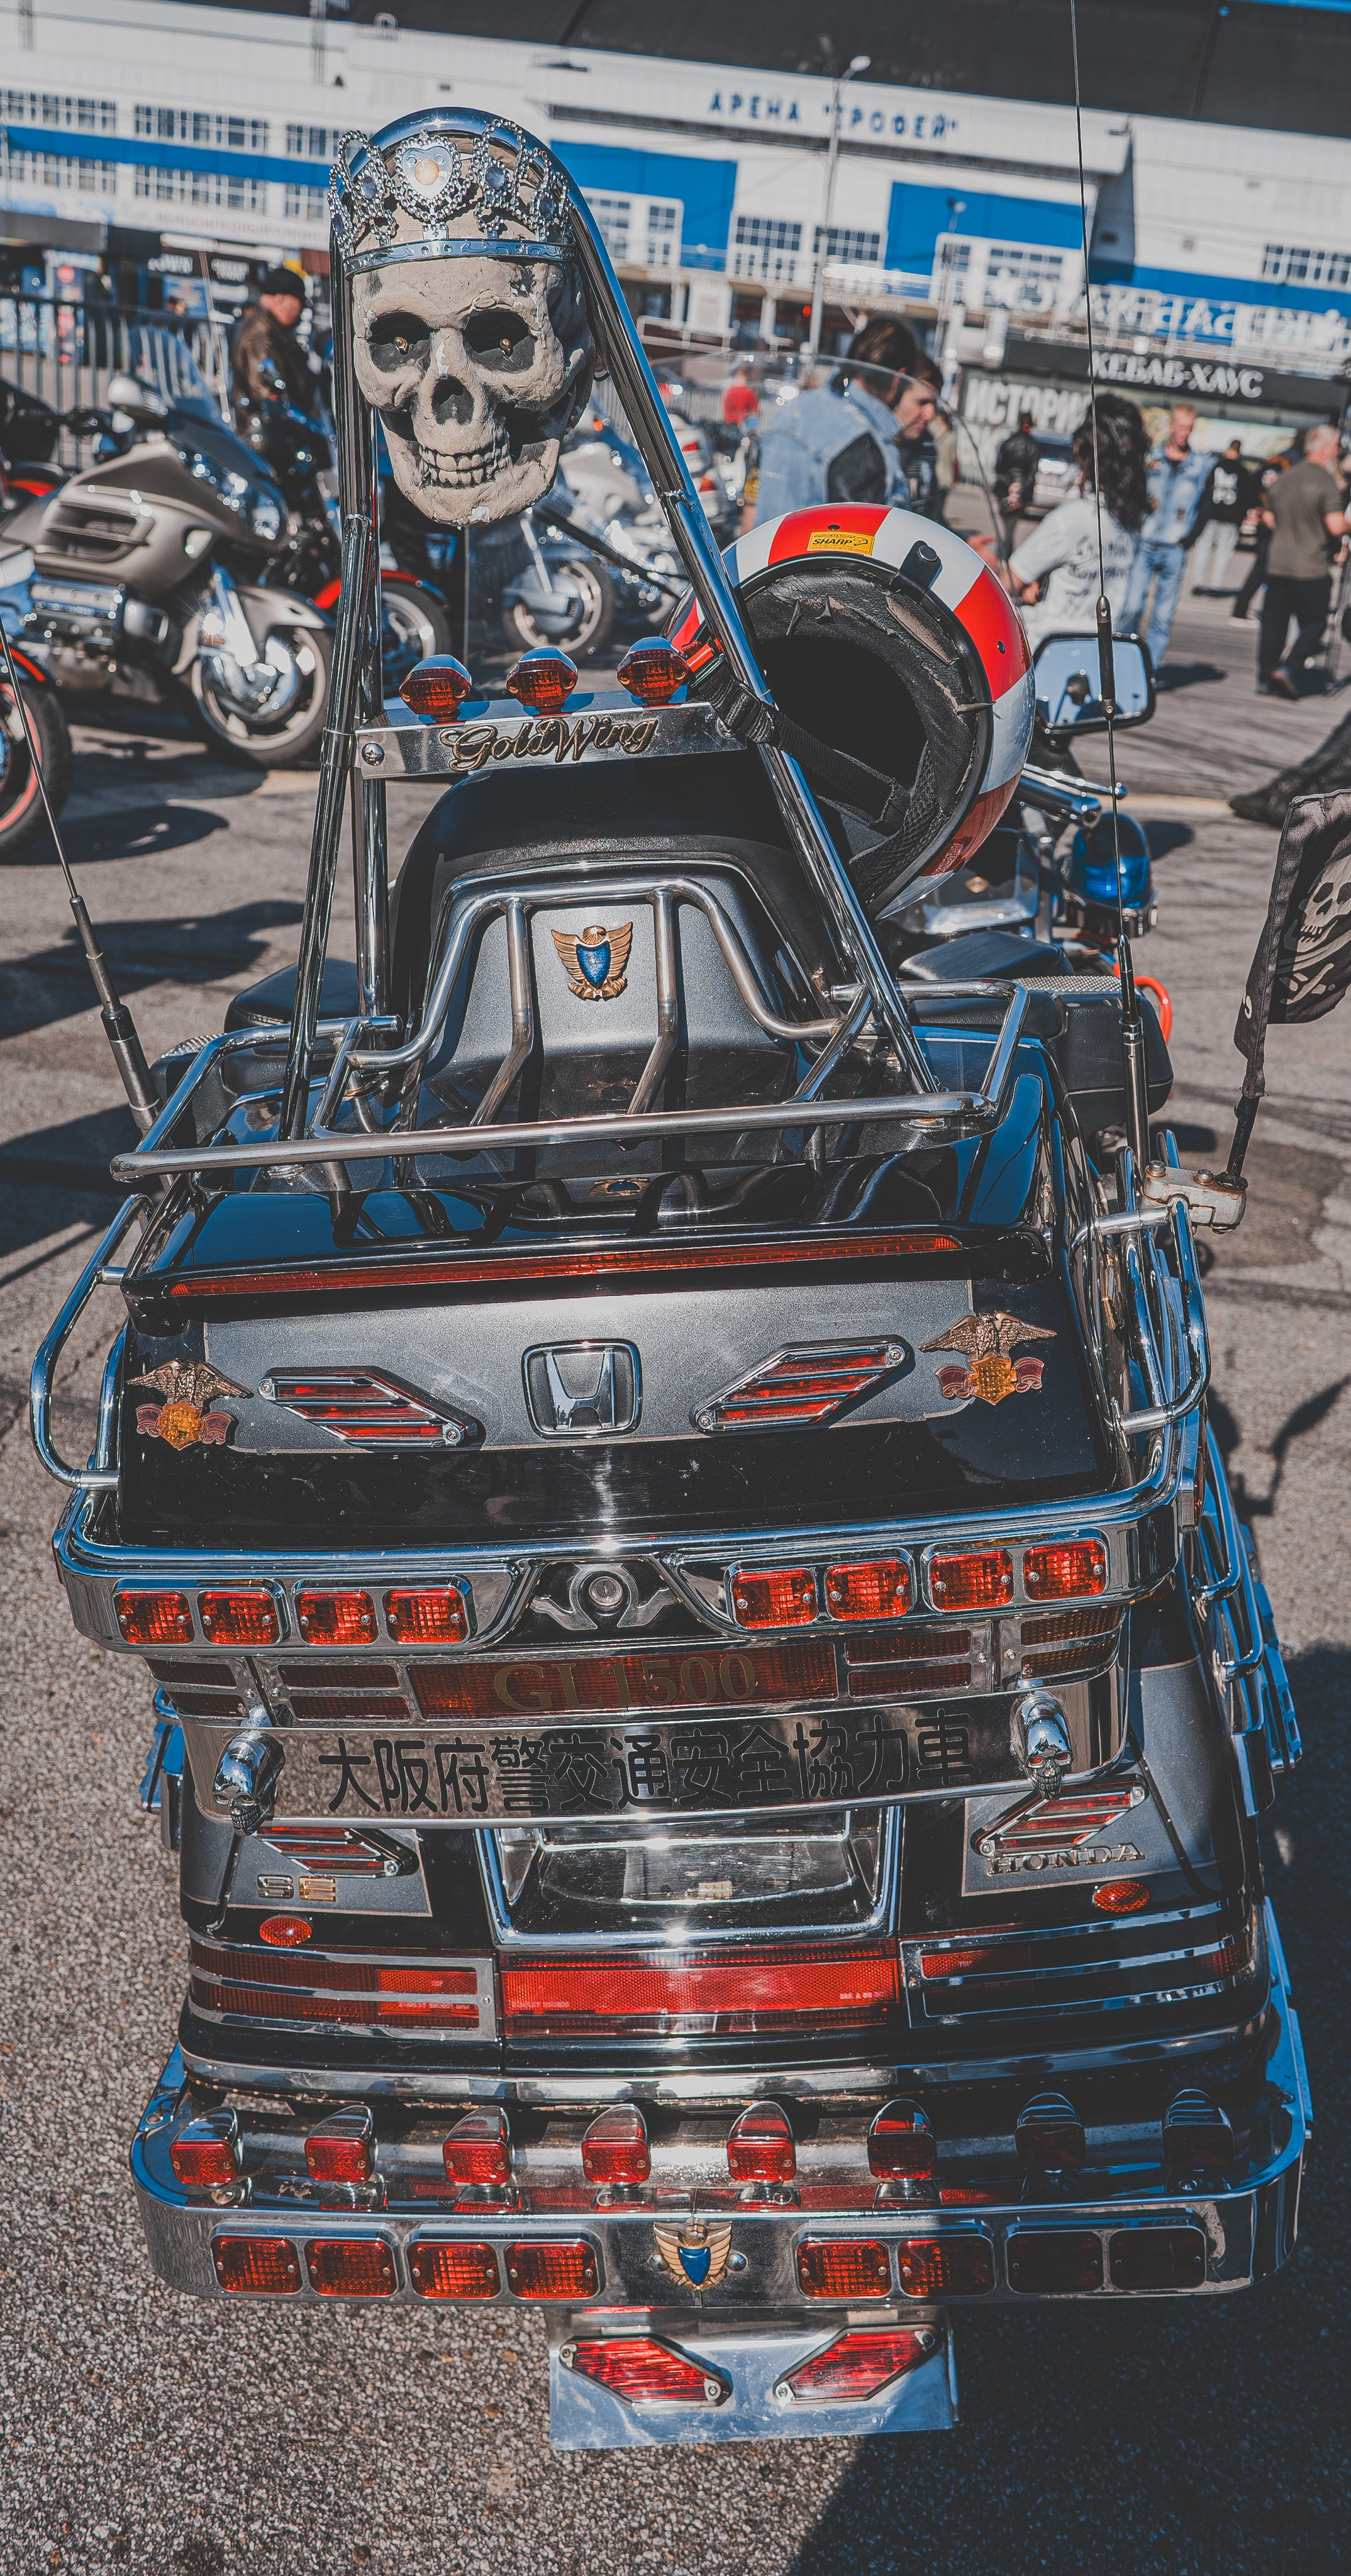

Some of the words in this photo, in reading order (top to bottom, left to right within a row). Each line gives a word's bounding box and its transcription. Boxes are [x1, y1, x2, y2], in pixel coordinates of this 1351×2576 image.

[710, 90, 800, 123] АРЕНА
[1092, 351, 1264, 398] КЕБАБ-ХАУС
[494, 1653, 756, 1711] GL1500
[318, 1708, 973, 1813] 大阪府警交通安全協力車
[987, 1842, 1146, 1876] HONDA
[257, 1874, 336, 1902] SE
